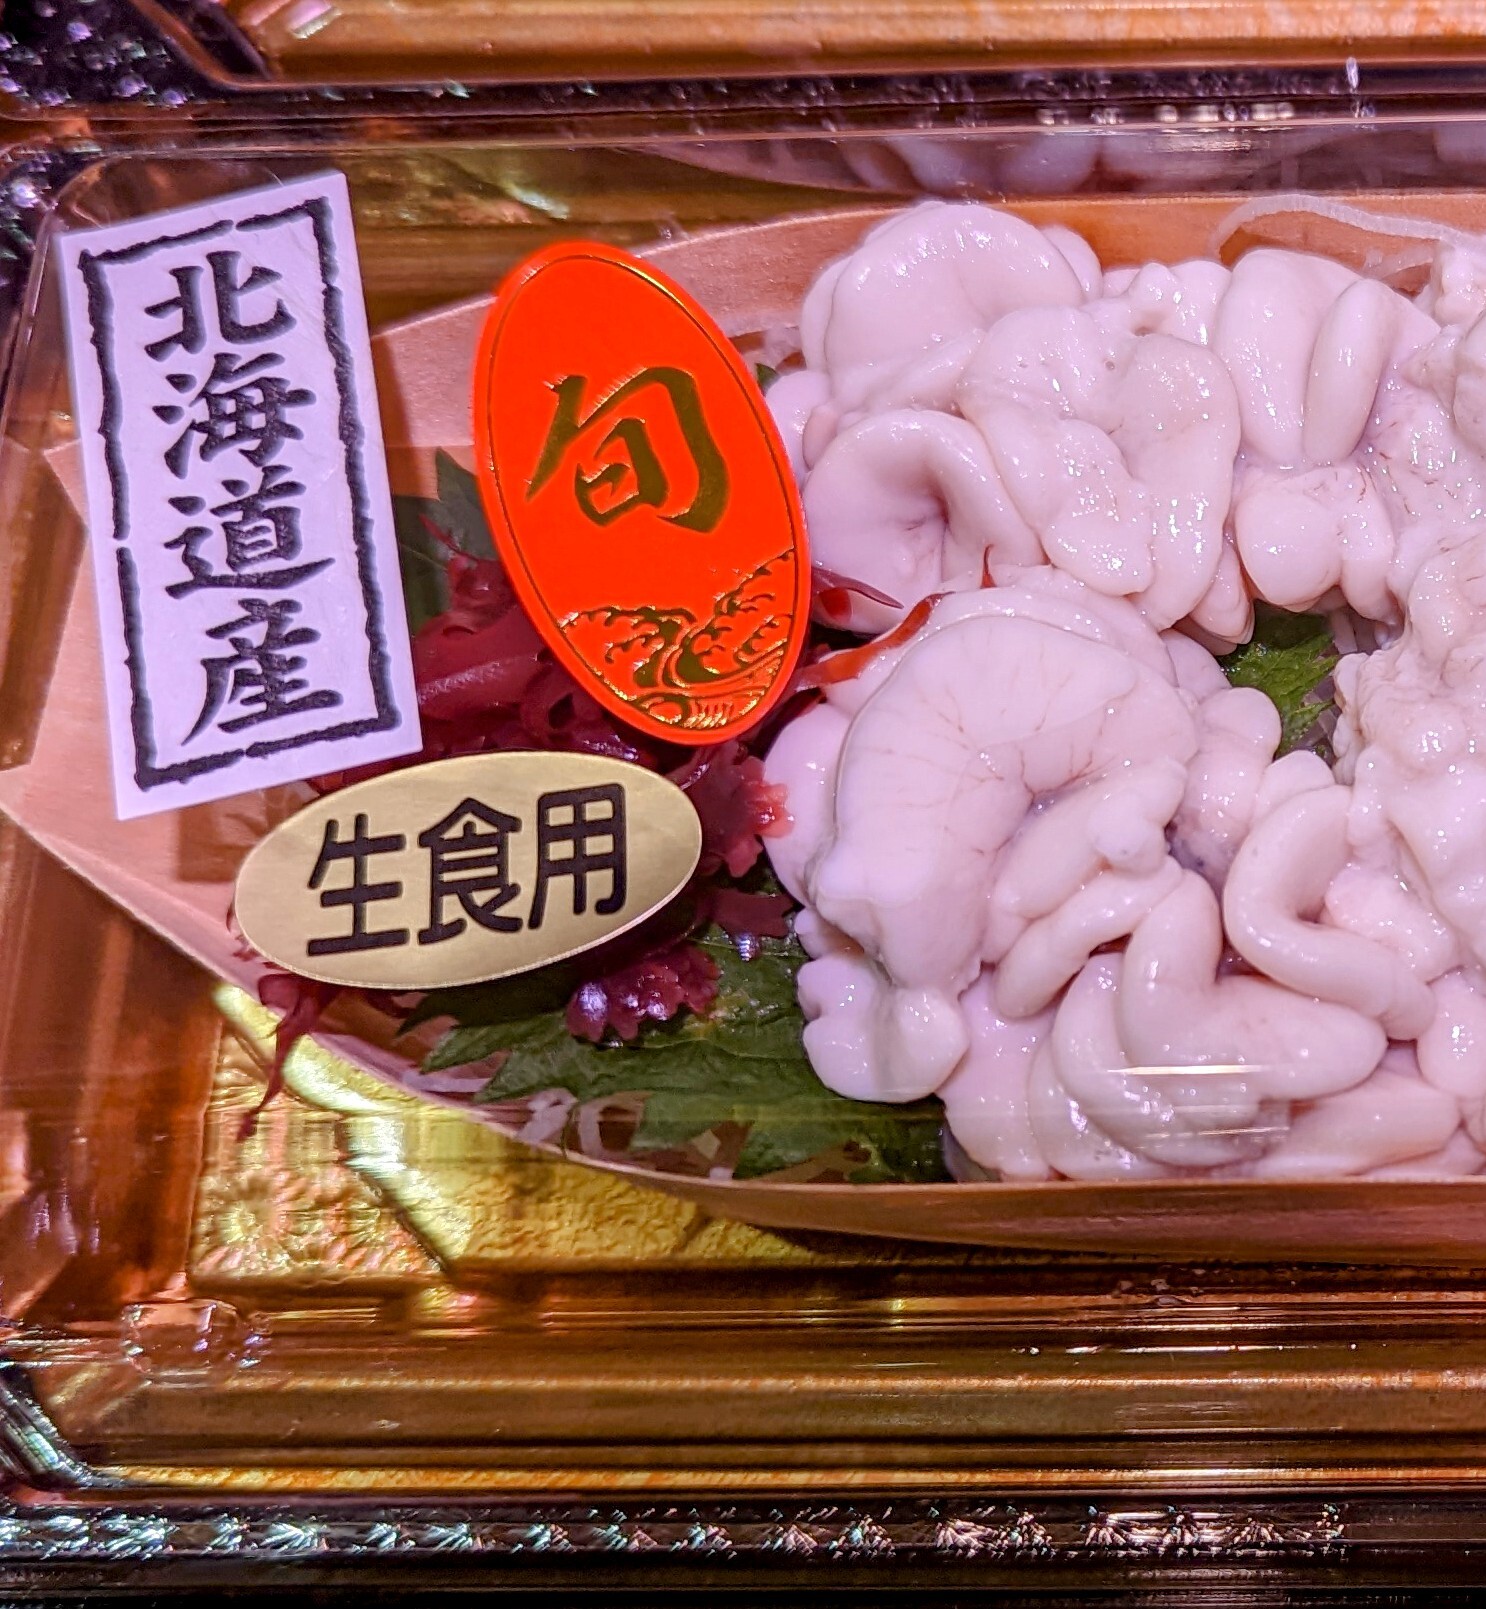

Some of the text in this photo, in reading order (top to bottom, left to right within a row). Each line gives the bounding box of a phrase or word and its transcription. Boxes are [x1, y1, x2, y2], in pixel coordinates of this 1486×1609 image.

[144, 250, 343, 746] 北海道産
[527, 366, 729, 534] 旬
[308, 781, 627, 957] 生食用
